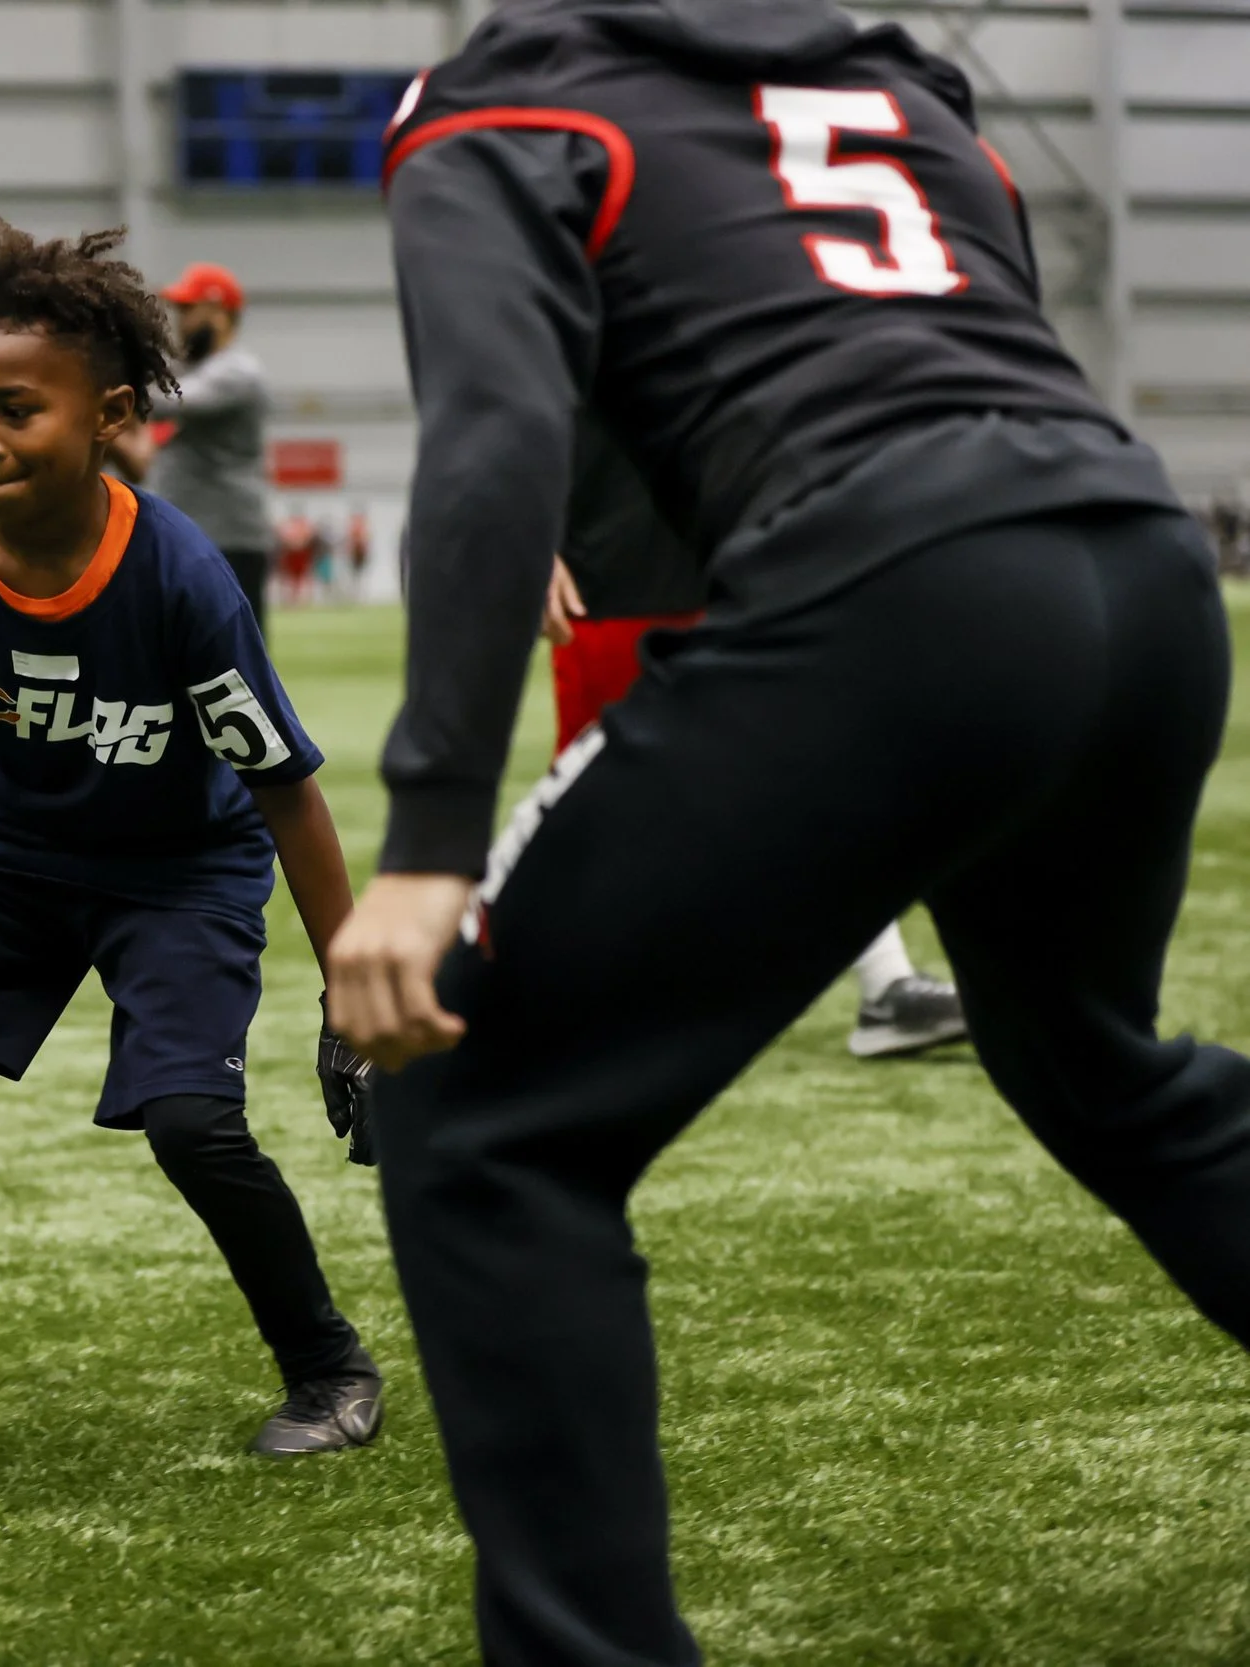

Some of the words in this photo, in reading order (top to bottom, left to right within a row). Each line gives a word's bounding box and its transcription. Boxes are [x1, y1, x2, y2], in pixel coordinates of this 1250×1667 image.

[753, 84, 969, 297] 5
[15, 686, 174, 766] FLAG
[192, 682, 267, 767] 5
